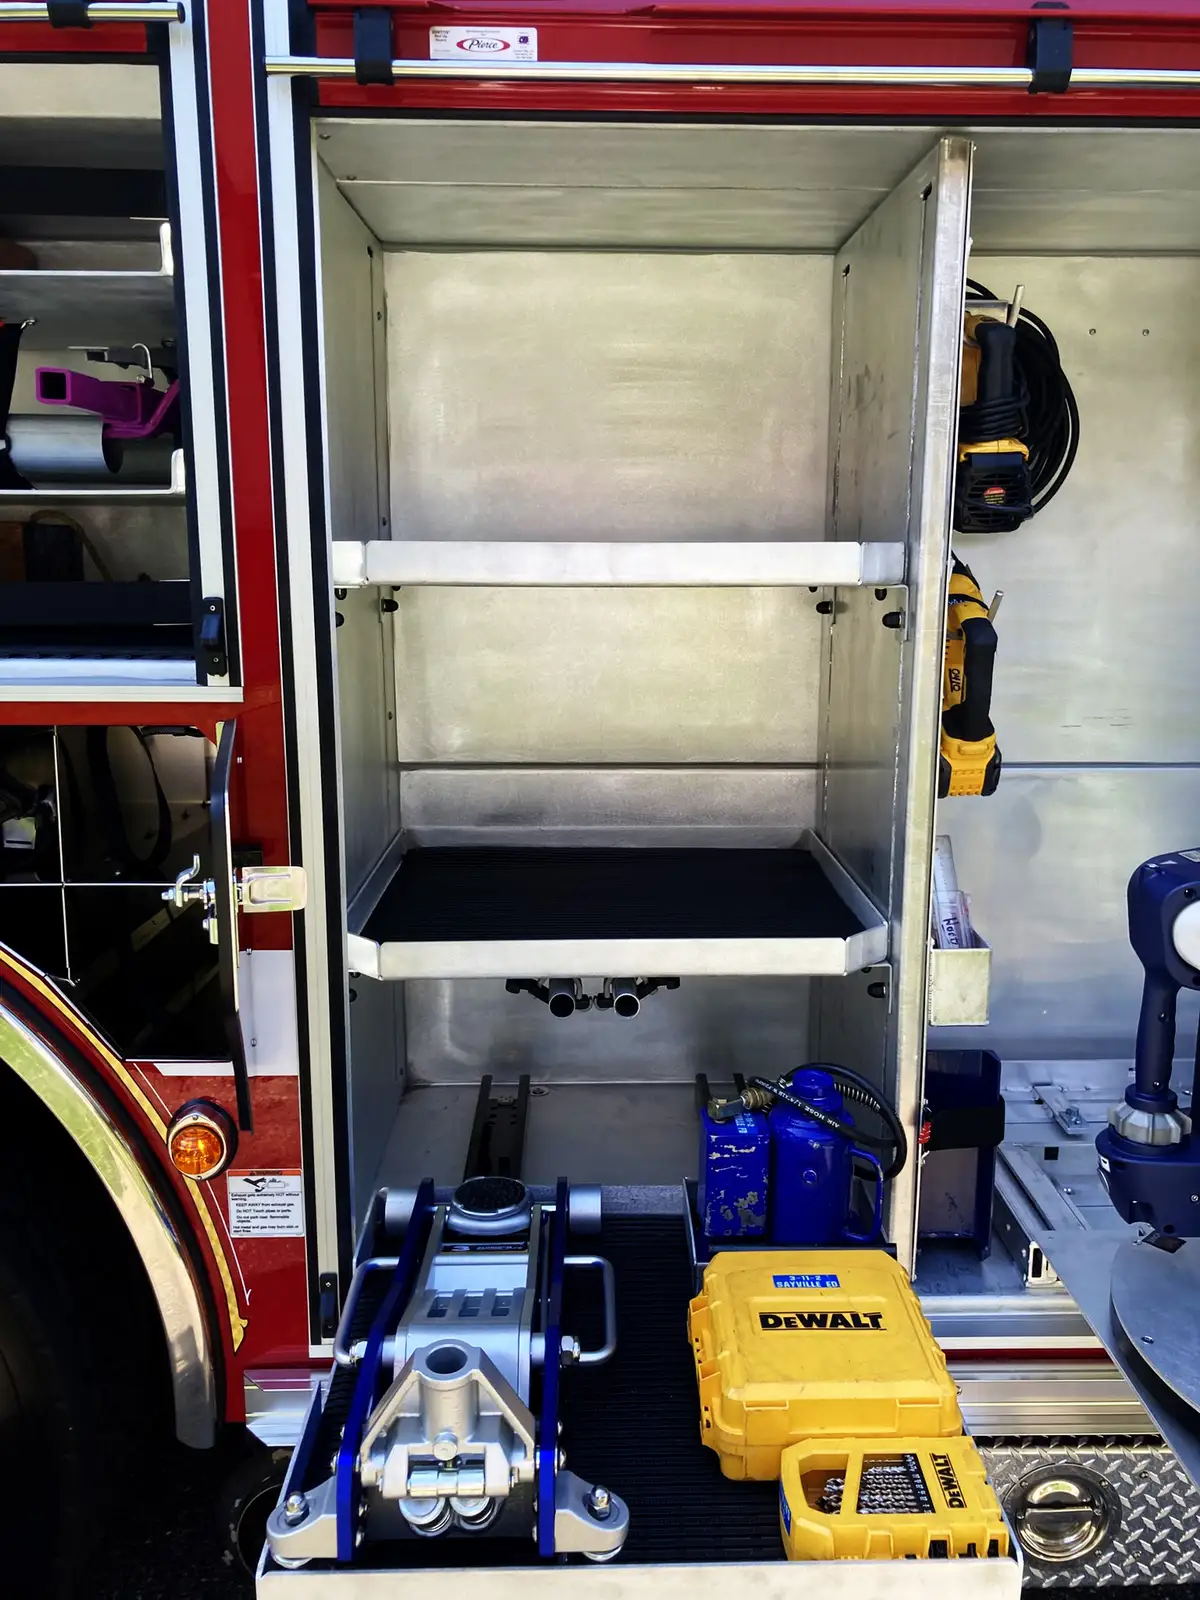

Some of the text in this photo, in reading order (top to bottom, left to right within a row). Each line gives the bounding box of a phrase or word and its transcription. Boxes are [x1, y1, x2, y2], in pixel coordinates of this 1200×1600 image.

[468, 39, 498, 50] Pierce
[804, 1106, 825, 1120] HOSE
[759, 1312, 883, 1330] DEWALT
[931, 1453, 966, 1508] DEWALT
